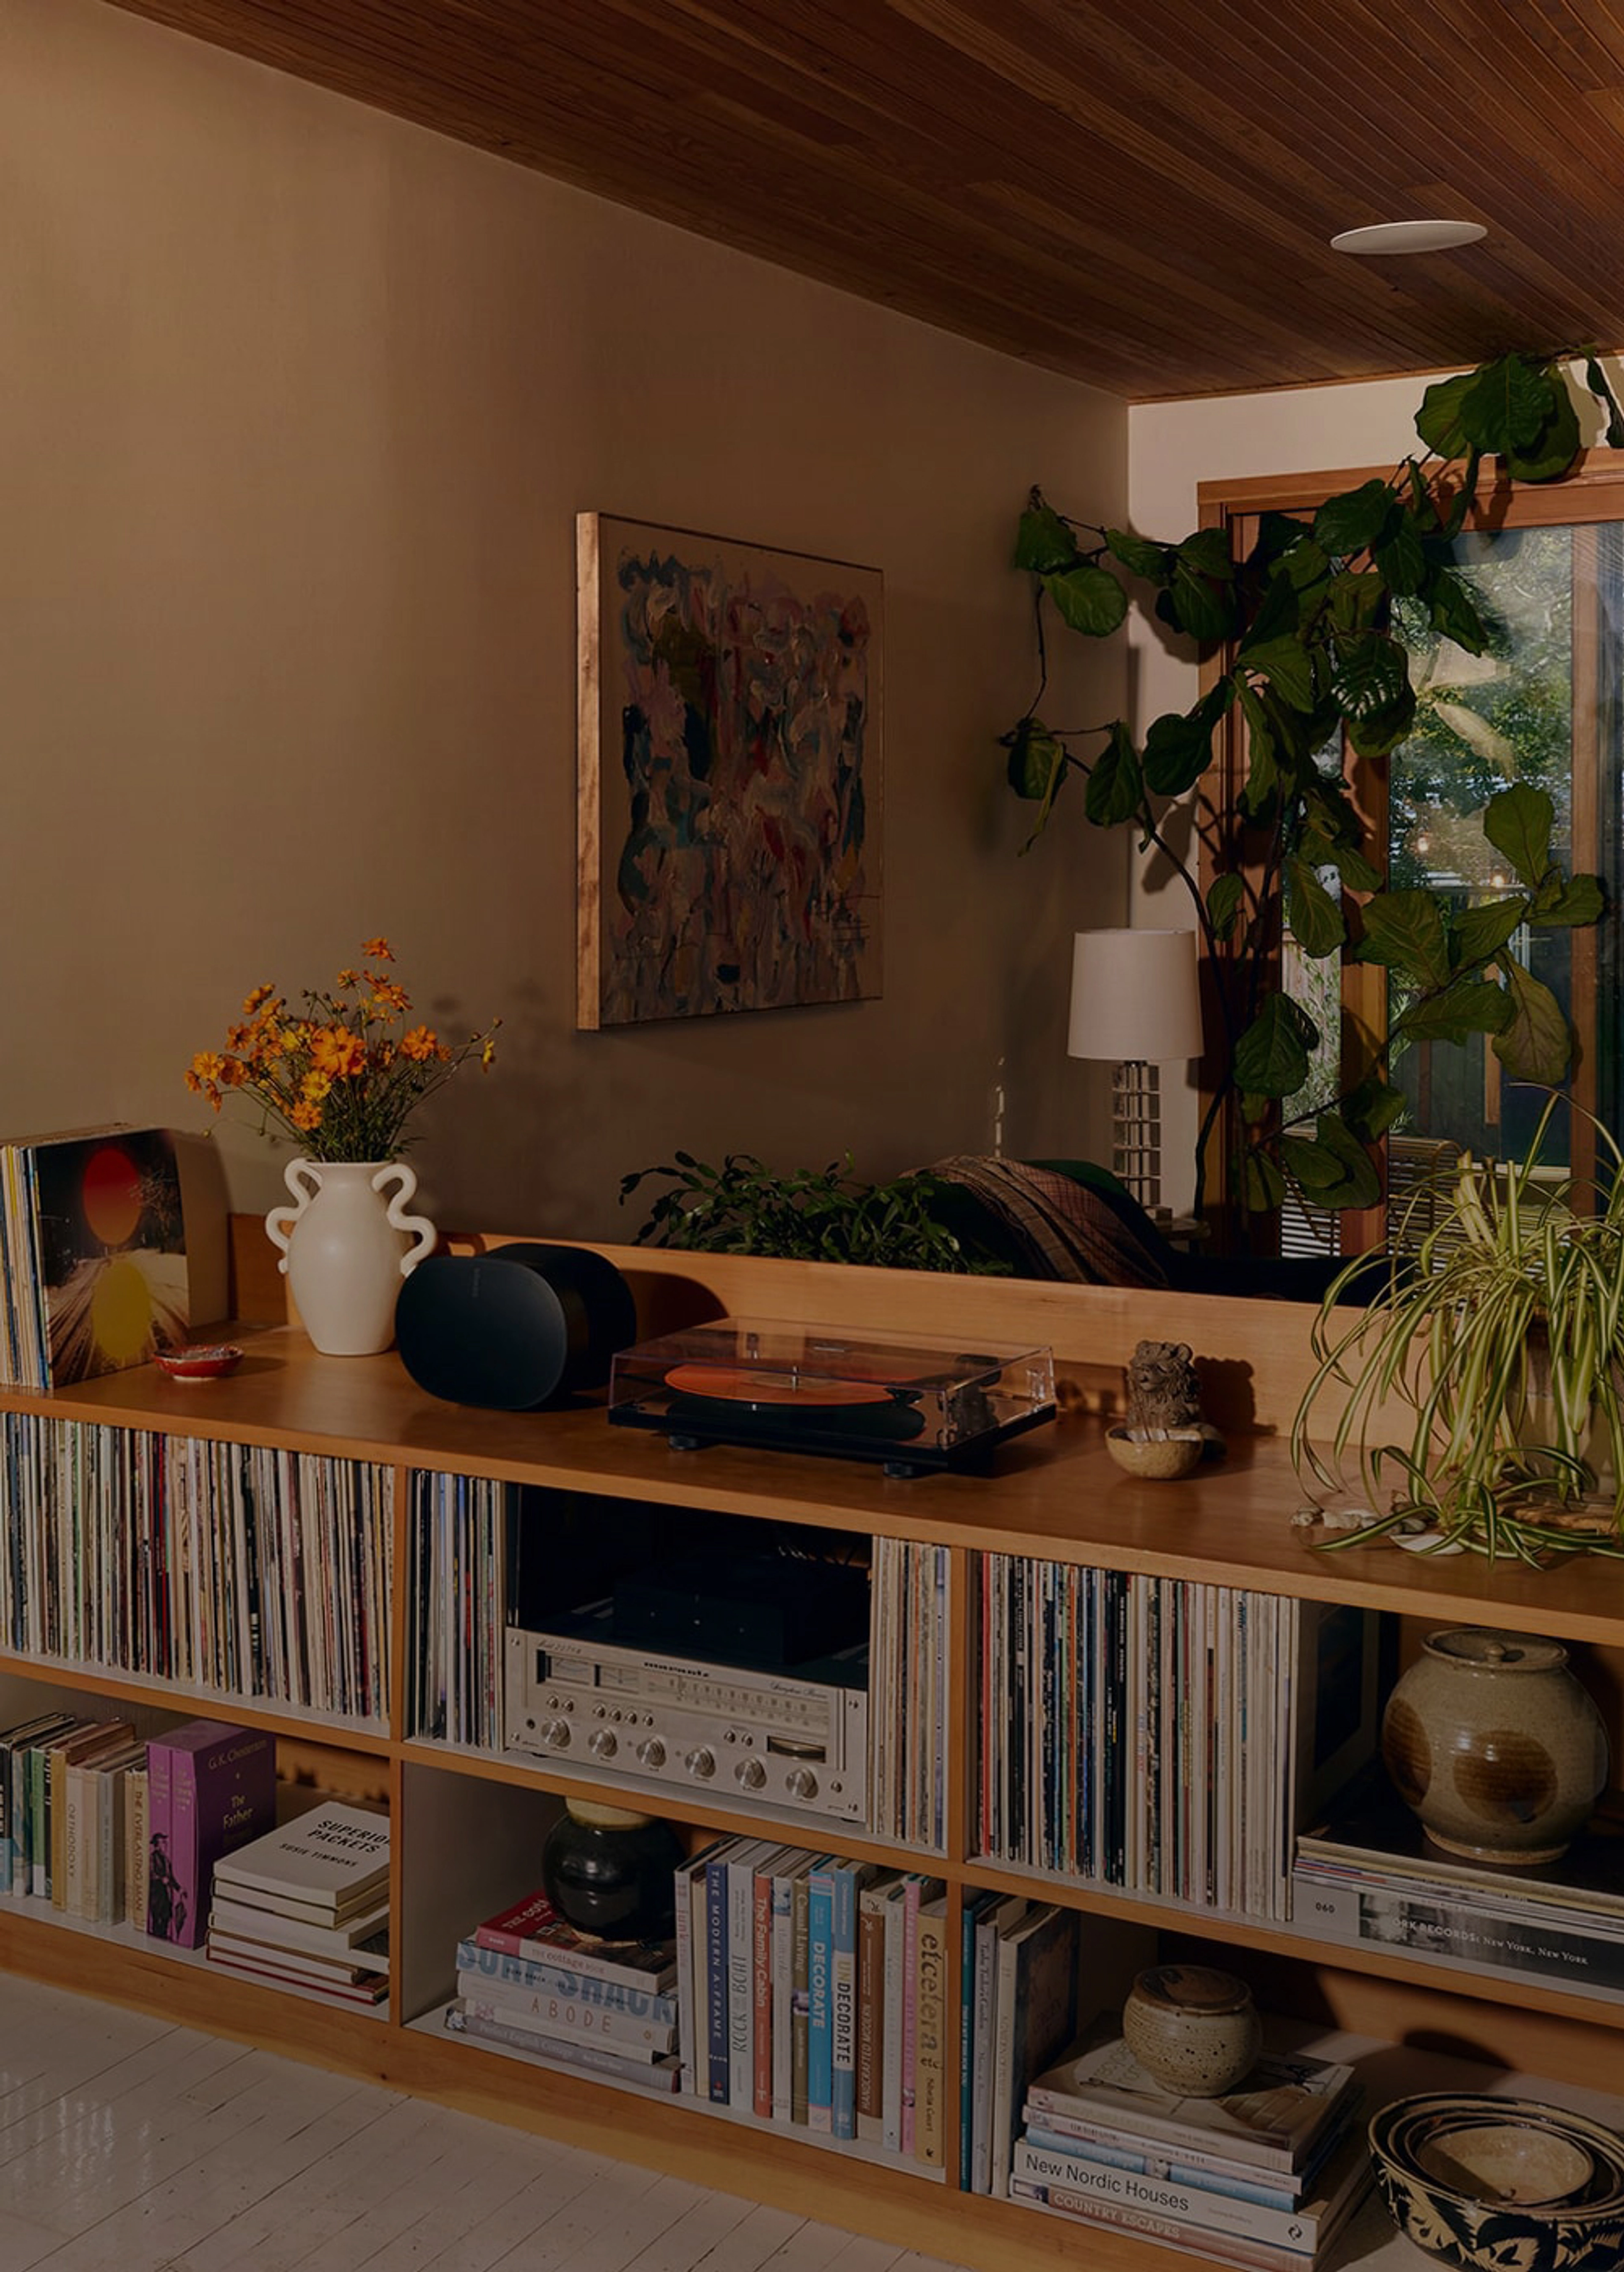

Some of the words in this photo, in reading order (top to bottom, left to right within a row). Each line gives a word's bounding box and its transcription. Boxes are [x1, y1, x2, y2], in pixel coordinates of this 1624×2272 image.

[308, 1829, 380, 1853] PACKETS
[711, 1870, 720, 1896] THE
[756, 1897, 767, 1922] The
[796, 1893, 808, 1933] Casual
[1316, 1903, 1336, 1914] 060
[711, 1905, 721, 1967] MODERN
[755, 1924, 767, 1968] Family
[795, 1934, 808, 1972] Living
[458, 1943, 543, 1986] SURF
[557, 1970, 675, 2025] SHACK
[713, 1973, 722, 2038] A-FRAME
[756, 1969, 767, 2008] Cabin
[812, 1940, 826, 2030] DECORATE
[921, 1934, 942, 2051] etcetera
[531, 1997, 612, 2034] ABODE
[837, 1960, 851, 2063] UNDECORATE
[1026, 2154, 1062, 2177] New
[1067, 2165, 1121, 2193] Nordic
[1126, 2177, 1189, 2212] Houses
[1054, 2193, 1117, 2222] COUNTRY
[1121, 2211, 1181, 2239] ESCAPES
